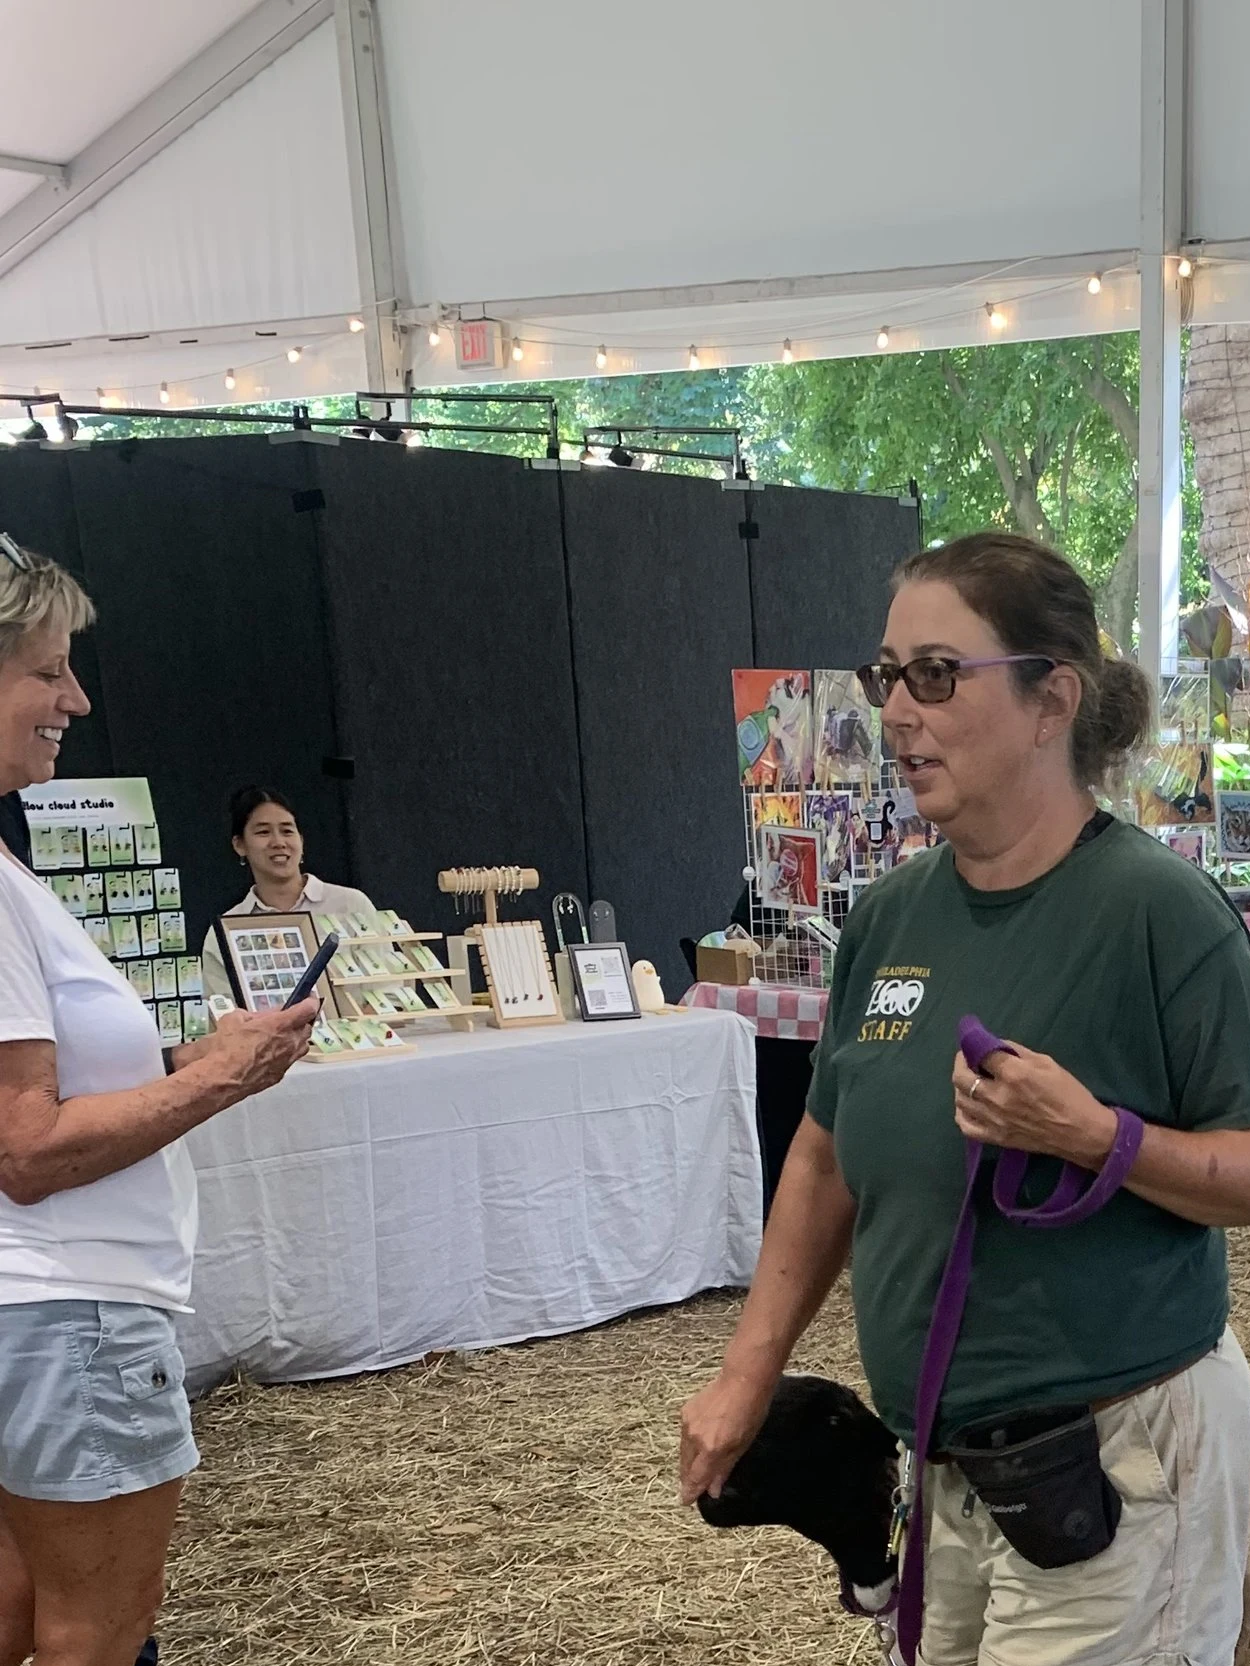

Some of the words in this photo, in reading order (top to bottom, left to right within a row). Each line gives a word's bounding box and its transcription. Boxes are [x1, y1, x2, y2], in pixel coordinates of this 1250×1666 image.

[461, 323, 487, 361] EXIT
[48, 799, 77, 810] cloud
[80, 798, 115, 809] studio
[865, 979, 925, 1017] ZOO
[857, 1019, 913, 1042] STAFF
